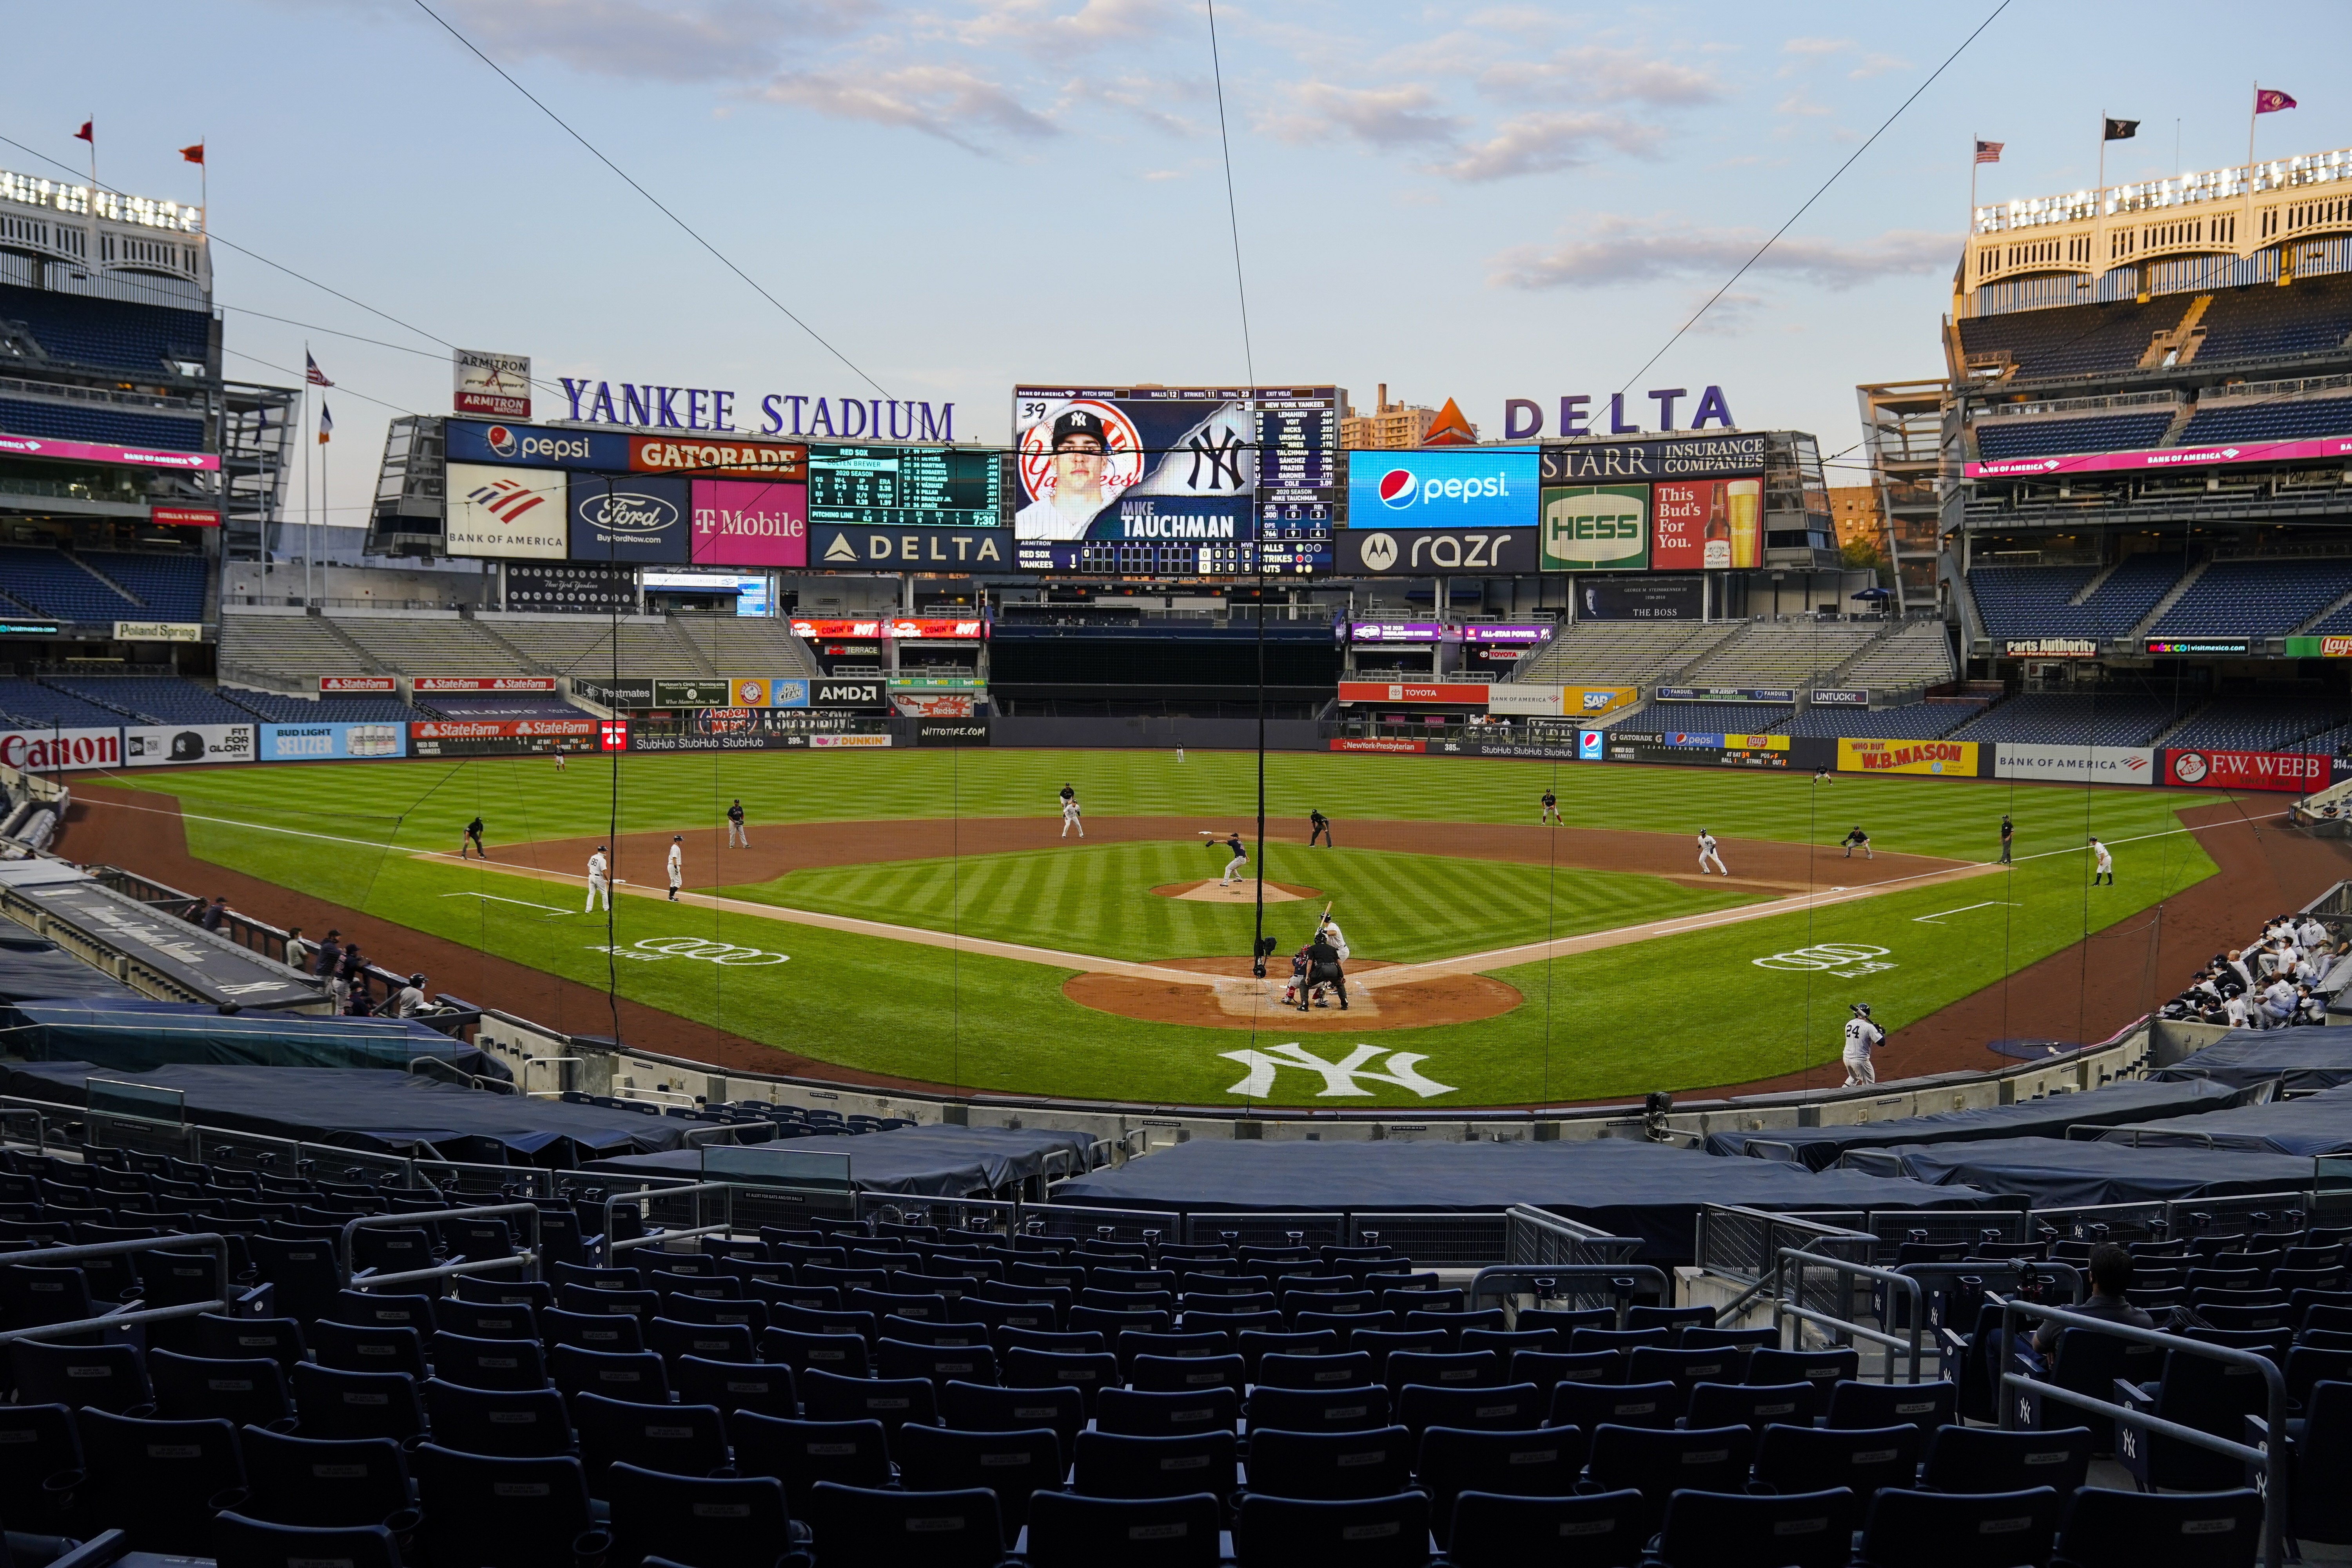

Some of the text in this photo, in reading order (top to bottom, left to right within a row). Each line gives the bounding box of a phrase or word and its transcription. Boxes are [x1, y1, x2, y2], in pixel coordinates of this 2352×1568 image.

[462, 356, 527, 372] ARMITRON
[464, 395, 524, 409] ARMITRON
[557, 378, 955, 442] YANKEE STADIUM
[1022, 403, 1047, 419] 39
[1505, 386, 1735, 439] DELTA
[522, 437, 590, 460] pepsi
[1665, 438, 1764, 458] INSURANCE
[154, 456, 188, 465] AMERICA
[641, 443, 796, 472] GATORADE
[1542, 447, 1651, 478] STARR
[1664, 453, 1764, 473] COMPANIES
[2183, 452, 2221, 461] AMERICA
[1424, 472, 1506, 504] pepsi
[1659, 487, 1694, 501] This
[597, 497, 660, 526] Ford
[1659, 502, 1701, 517] Bud's
[973, 515, 996, 525] 7:30
[1120, 502, 1234, 538] MIKE TAUCHMAN
[1552, 514, 1638, 540] HESS
[1659, 519, 1684, 533] For
[449, 534, 562, 546] BANK OF AMERICA
[597, 534, 661, 544] BuyFordNow.com
[1658, 534, 1691, 548] You.
[870, 535, 1000, 561] DELTA
[1412, 534, 1512, 567] razr
[120, 624, 196, 639] Poland Spring
[853, 623, 877, 635] HOT
[925, 625, 948, 633] COMIN'
[956, 622, 980, 635] HOT
[2007, 638, 2096, 652] Parts Authority
[603, 689, 650, 698] Postmates
[778, 688, 802, 702] CLEAN
[784, 684, 798, 692] OXI
[819, 687, 860, 700] AMD
[1584, 694, 1608, 706] SAP
[1816, 693, 1856, 701] UNTUCKit
[922, 726, 985, 737] NITTOTIRE.COM
[276, 736, 333, 755] SELTZER
[637, 739, 675, 749] StubHub
[679, 739, 719, 748] StubHub
[722, 738, 764, 748] StubHub
[842, 736, 886, 746] DUNKIN'
[1689, 736, 1713, 745] pepsi
[1748, 736, 1766, 747] Lay's
[0, 735, 117, 768] Canon
[1482, 746, 1511, 754] StubHub
[1514, 747, 1542, 755] StubHub
[1544, 748, 1572, 757] StubHub
[2000, 757, 2117, 770] BANK OF AMERICA
[2212, 755, 2320, 778] F.W. WEBB
[2333, 759, 2346, 769] 314
[1846, 1025, 1860, 1038] 24
